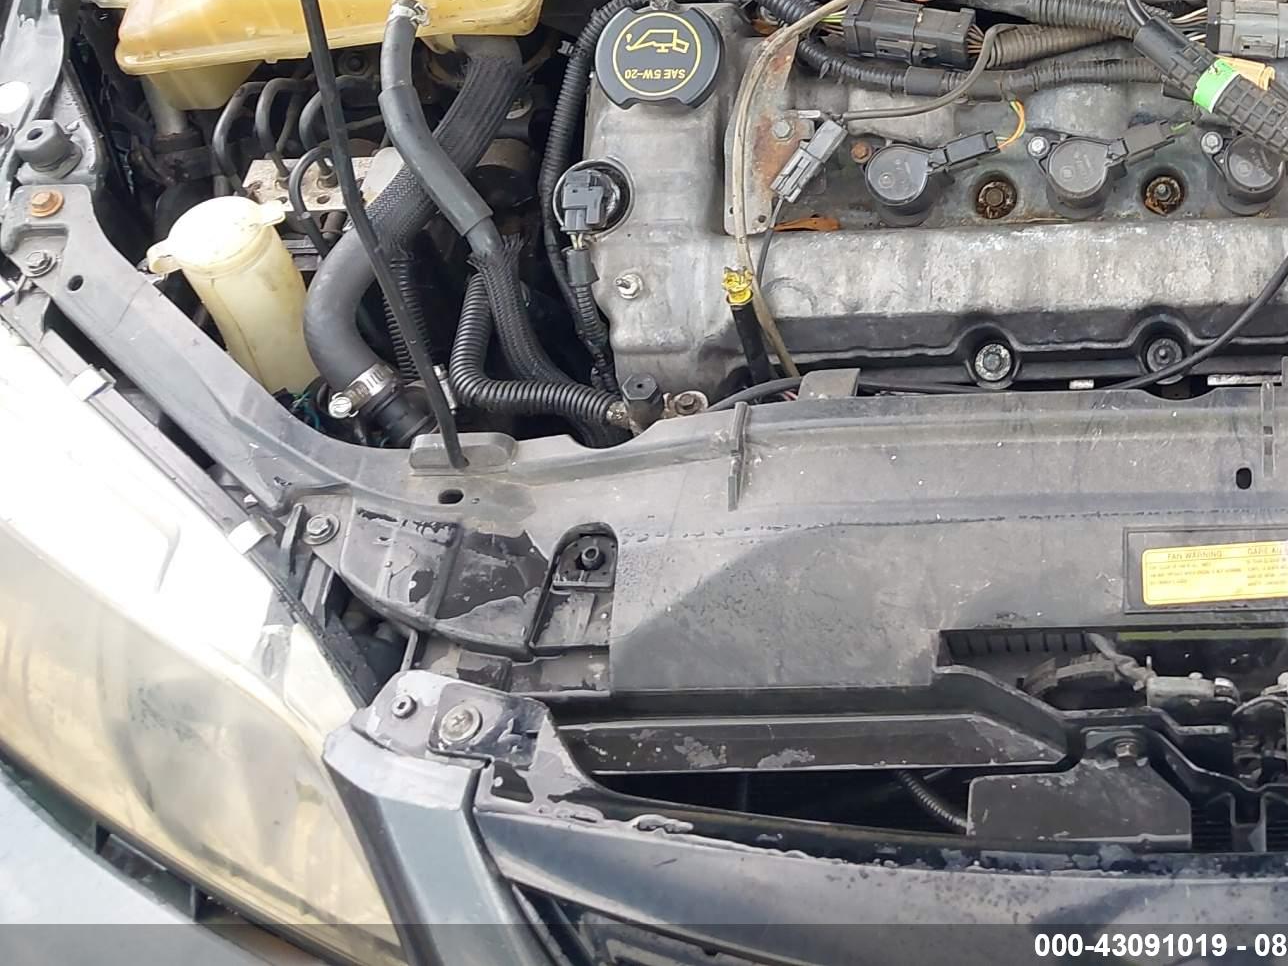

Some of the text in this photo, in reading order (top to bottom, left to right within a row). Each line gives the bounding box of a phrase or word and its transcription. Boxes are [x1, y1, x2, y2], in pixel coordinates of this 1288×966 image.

[624, 68, 686, 80] SAE 5W-20
[1185, 550, 1223, 559] WARNING
